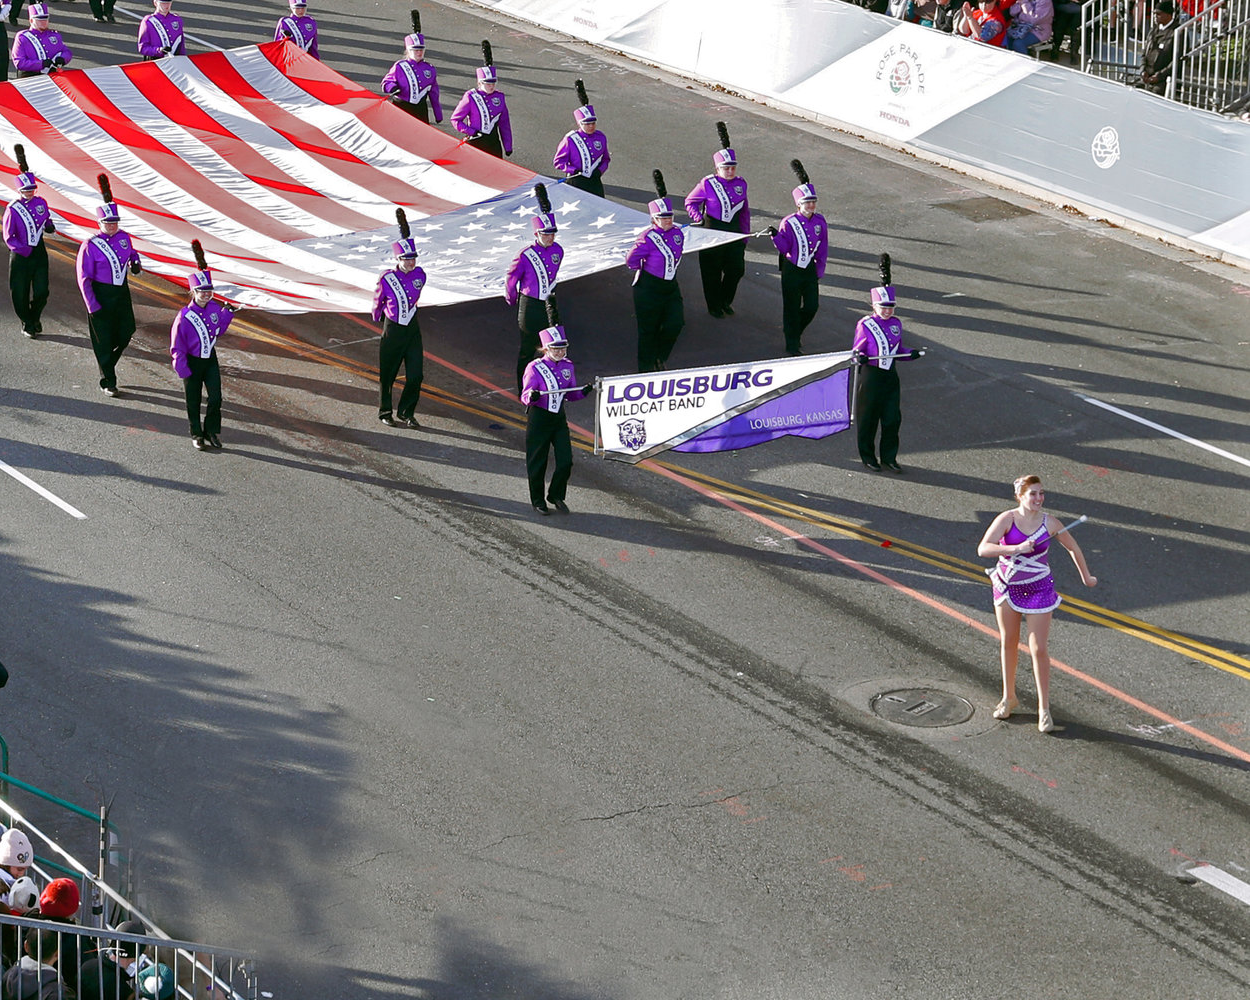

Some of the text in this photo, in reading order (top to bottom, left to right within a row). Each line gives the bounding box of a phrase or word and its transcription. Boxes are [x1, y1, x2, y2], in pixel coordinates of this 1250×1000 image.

[573, 15, 599, 30] HONDA
[876, 43, 926, 95] ROSE PARADE
[879, 110, 911, 128] HONDA
[529, 252, 547, 294] LOUISBURG
[389, 277, 407, 319] LOUISBURG
[538, 365, 558, 410] LOUISURG
[607, 368, 773, 404] LOUISBURG
[605, 396, 706, 418] WILDCAT BAND
[750, 408, 844, 430] LOUISBURG, KANSAS
